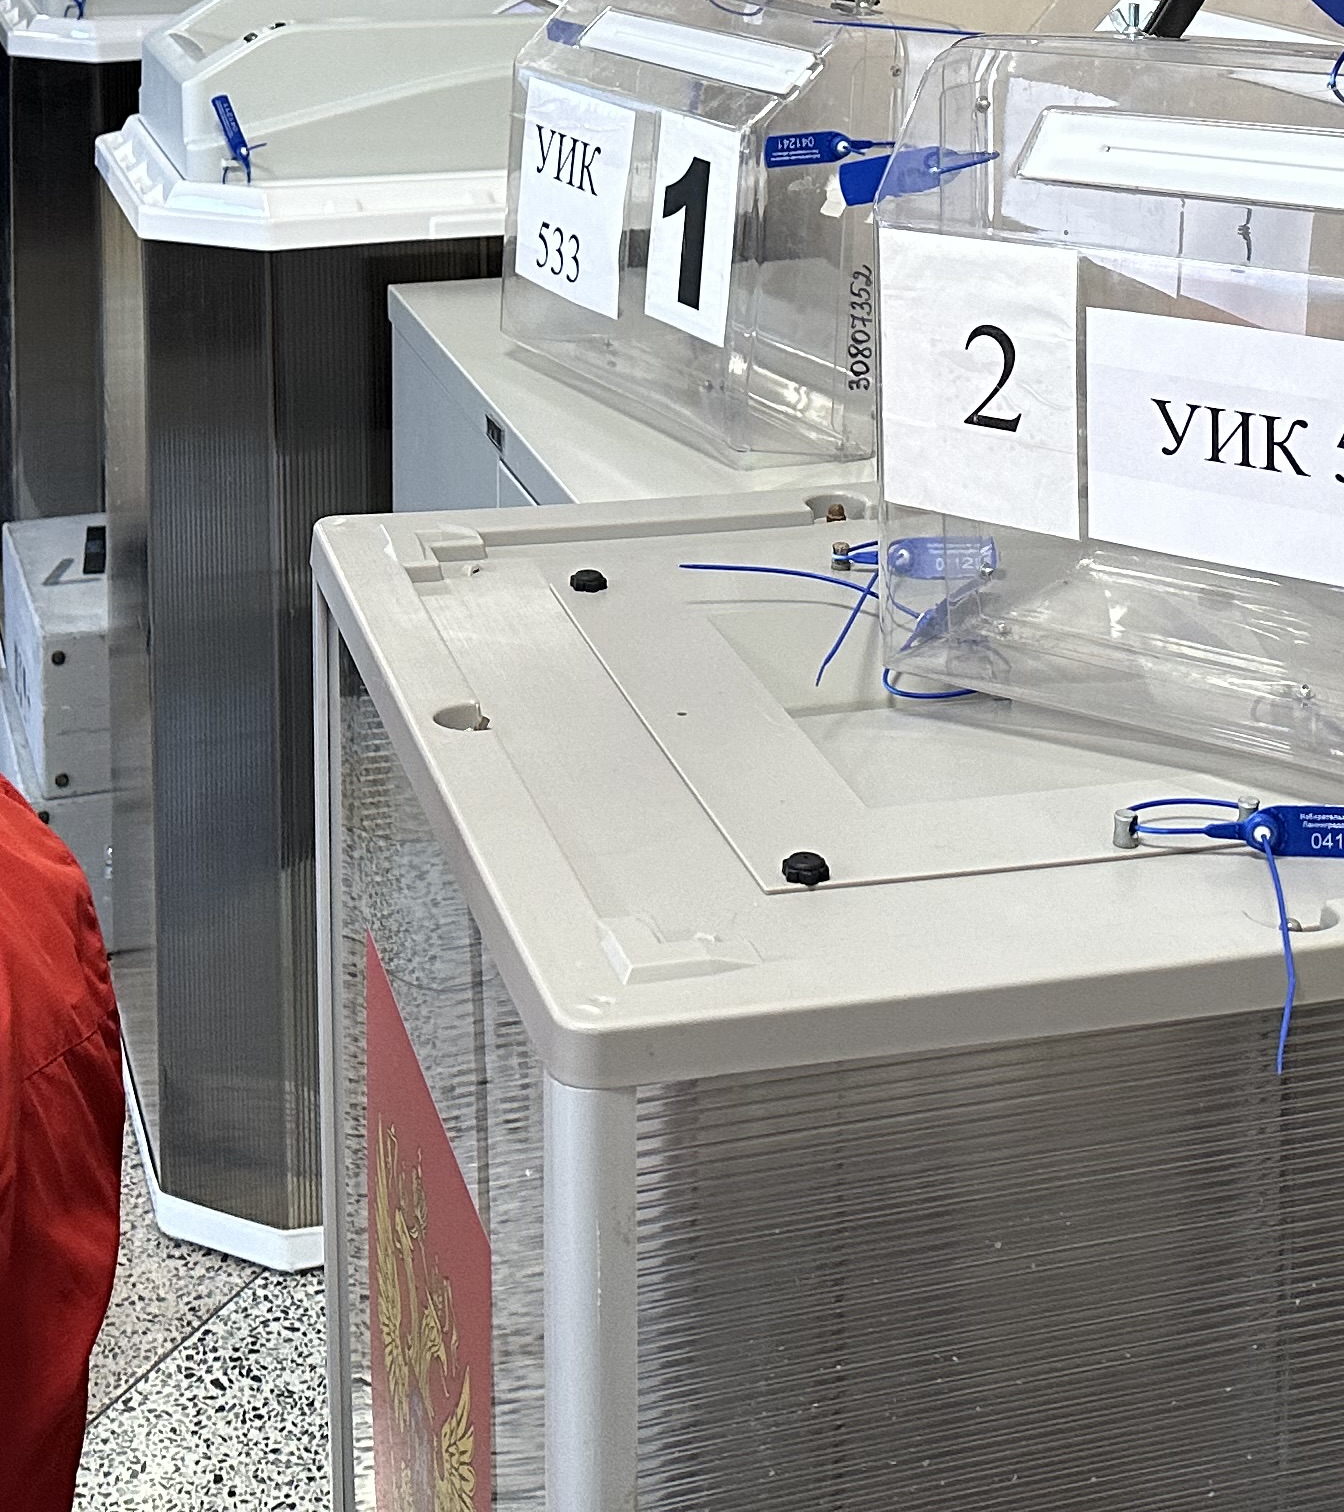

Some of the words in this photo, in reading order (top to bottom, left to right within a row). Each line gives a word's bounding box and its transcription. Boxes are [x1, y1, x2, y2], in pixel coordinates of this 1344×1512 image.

[536, 124, 602, 196] УИК
[536, 221, 581, 283] 533
[662, 156, 711, 311] 1
[848, 263, 873, 392] 30807352
[963, 324, 1022, 433] 2
[1150, 398, 1312, 478] УИК
